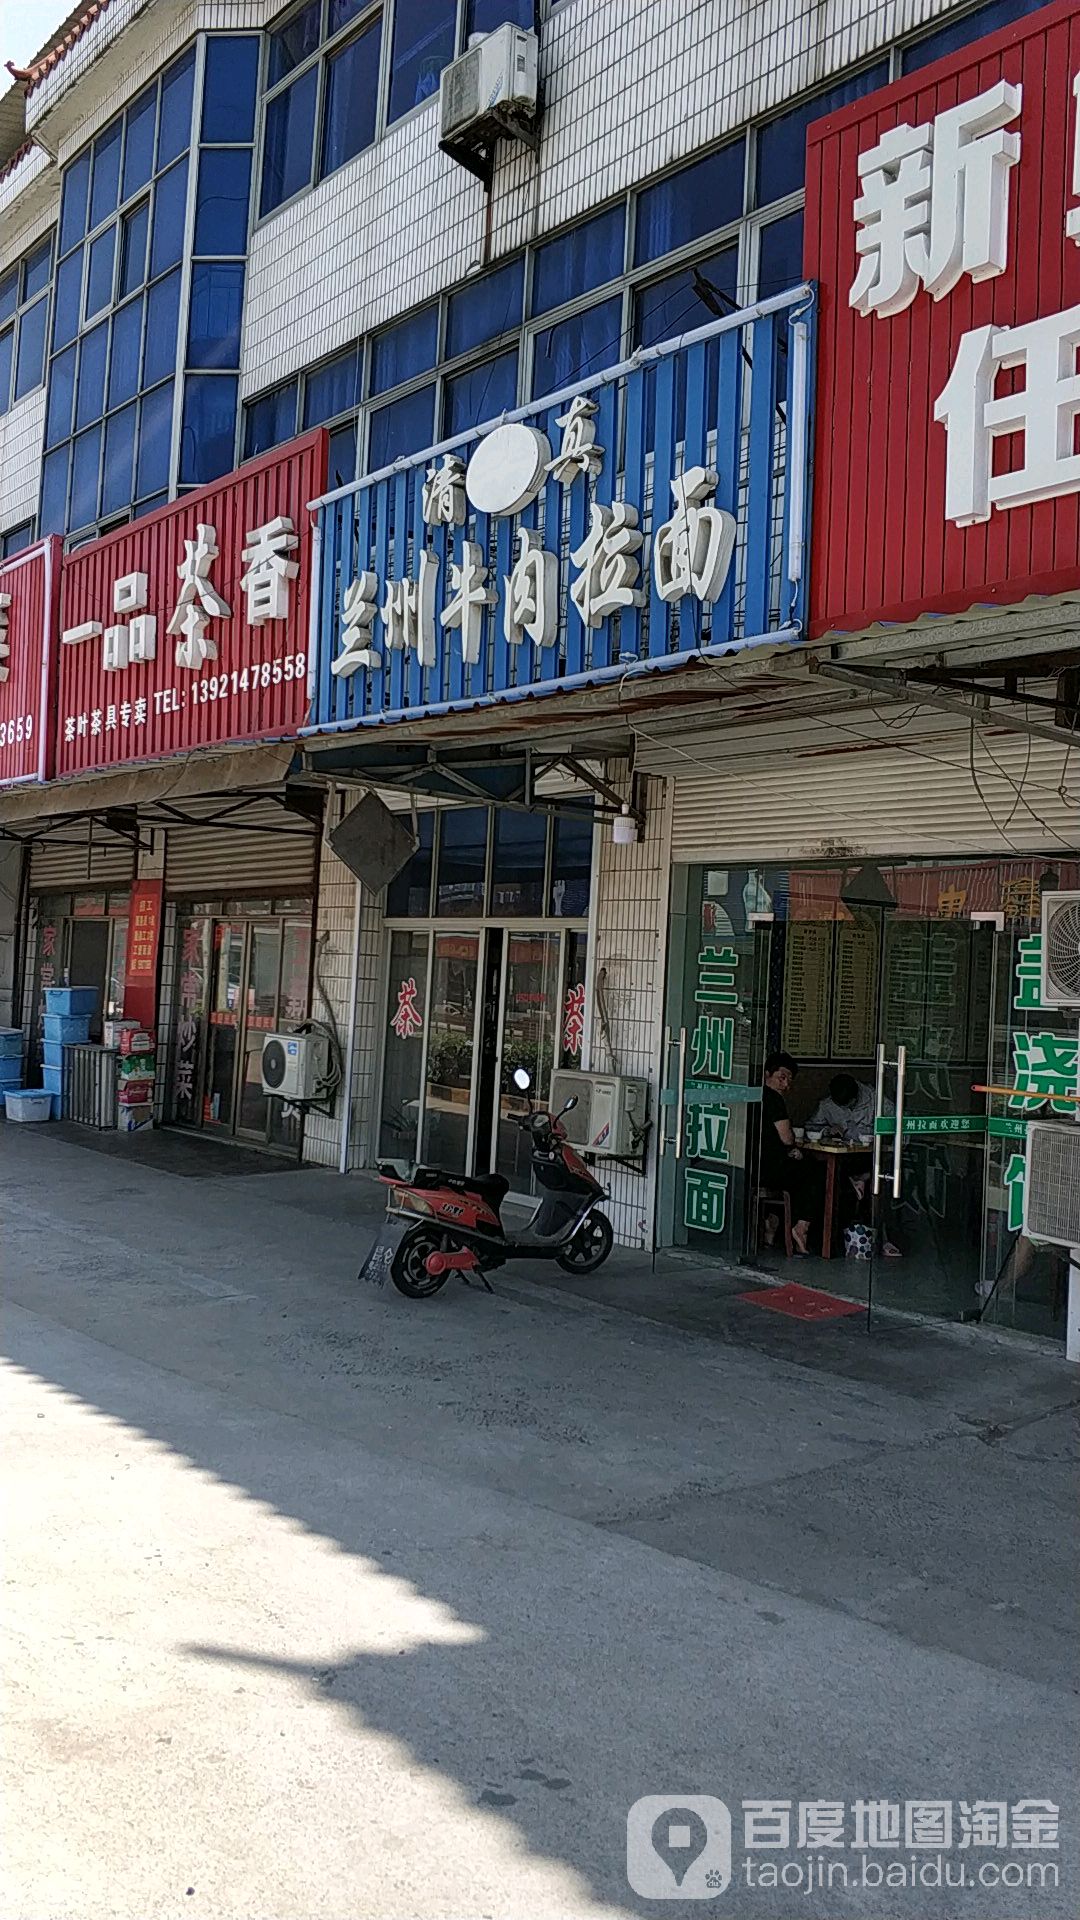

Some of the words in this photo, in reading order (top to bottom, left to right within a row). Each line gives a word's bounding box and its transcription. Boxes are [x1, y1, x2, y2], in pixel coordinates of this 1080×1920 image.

[848, 72, 1080, 319] 新
[421, 454, 467, 527] 清
[543, 396, 606, 485] 真
[62, 515, 300, 672] 一品茶香
[331, 465, 737, 679] 兰州牛肉拉面
[64, 696, 147, 742] 茶叶茶具专卖
[191, 652, 306, 705] 13921478558
[390, 977, 423, 1040] 茶
[562, 983, 586, 1056] 茶
[684, 945, 740, 1234] 兰州拉面
[904, 1118, 971, 1131] 州拉面欢迎您
